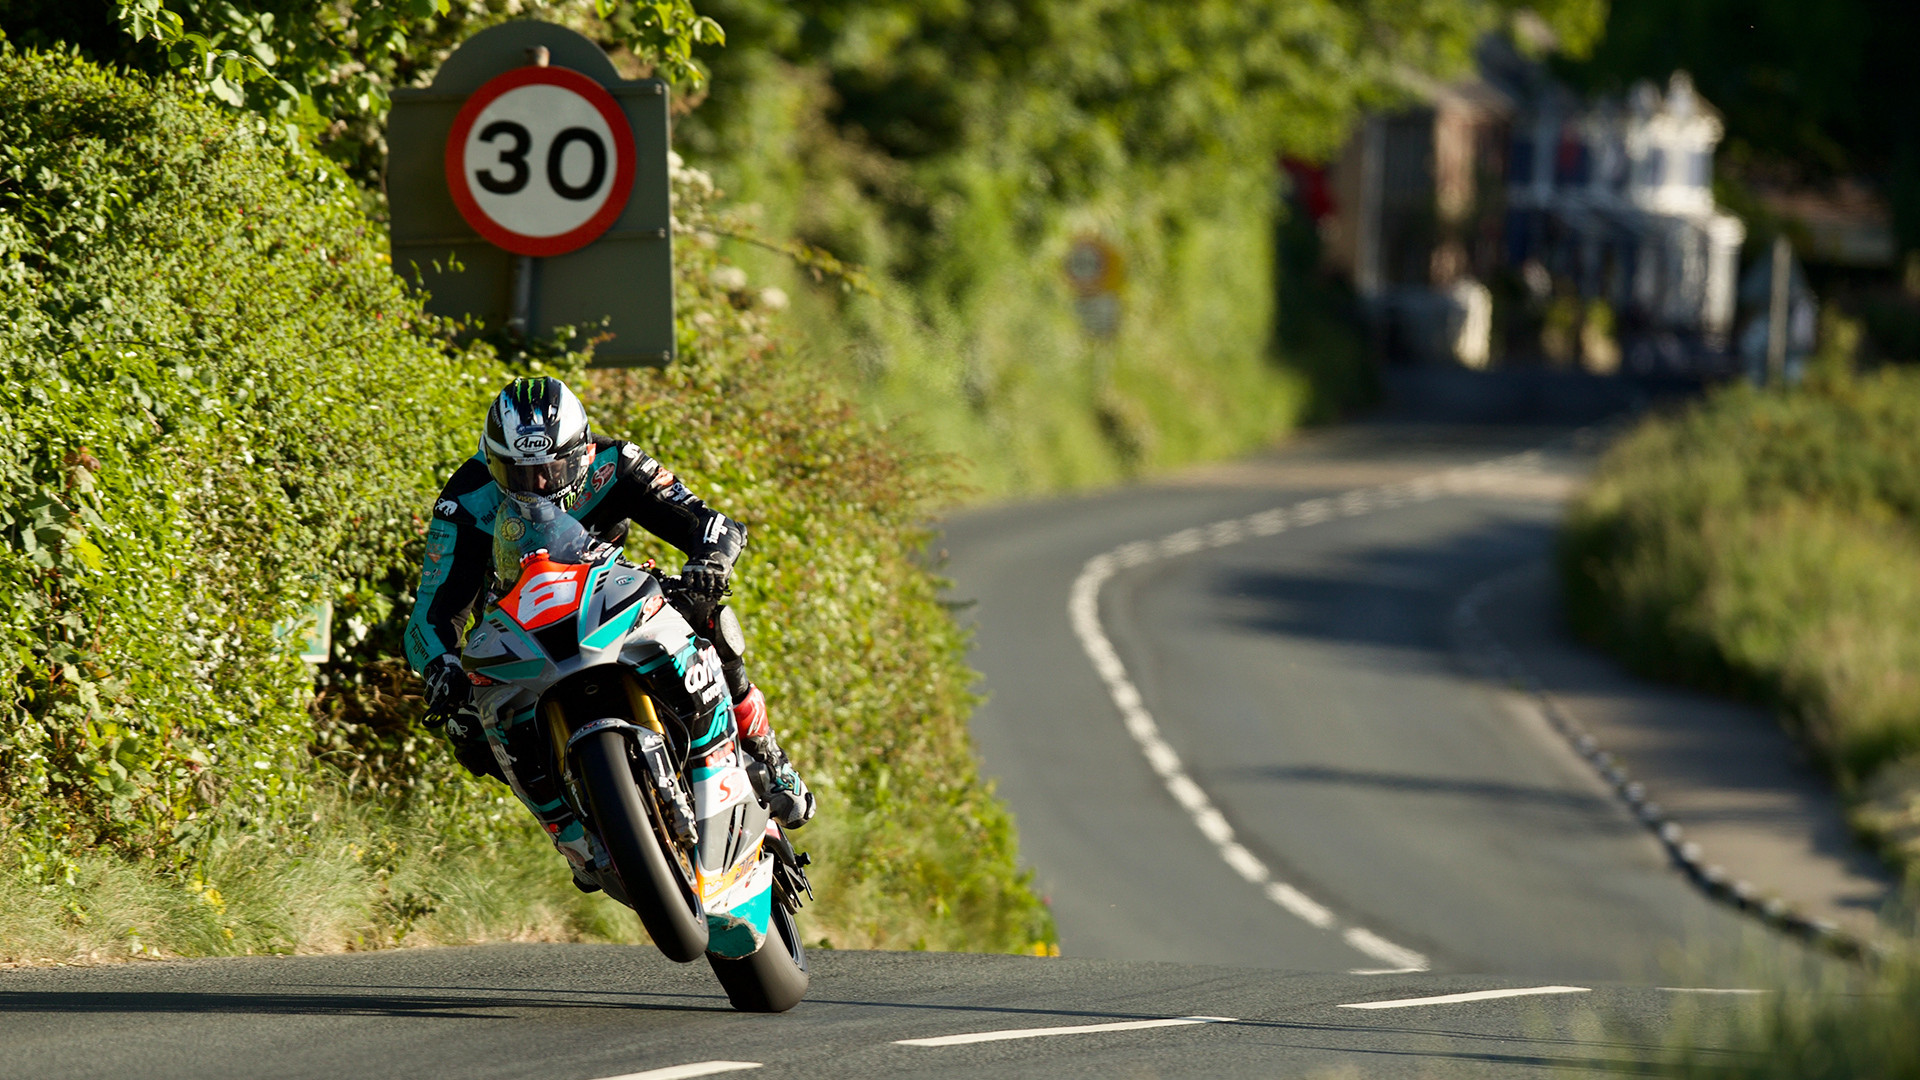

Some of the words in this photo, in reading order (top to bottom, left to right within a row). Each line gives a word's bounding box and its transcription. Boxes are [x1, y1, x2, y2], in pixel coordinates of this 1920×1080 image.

[475, 120, 608, 201] 30
[517, 436, 547, 449] Arai
[516, 570, 578, 625] 6
